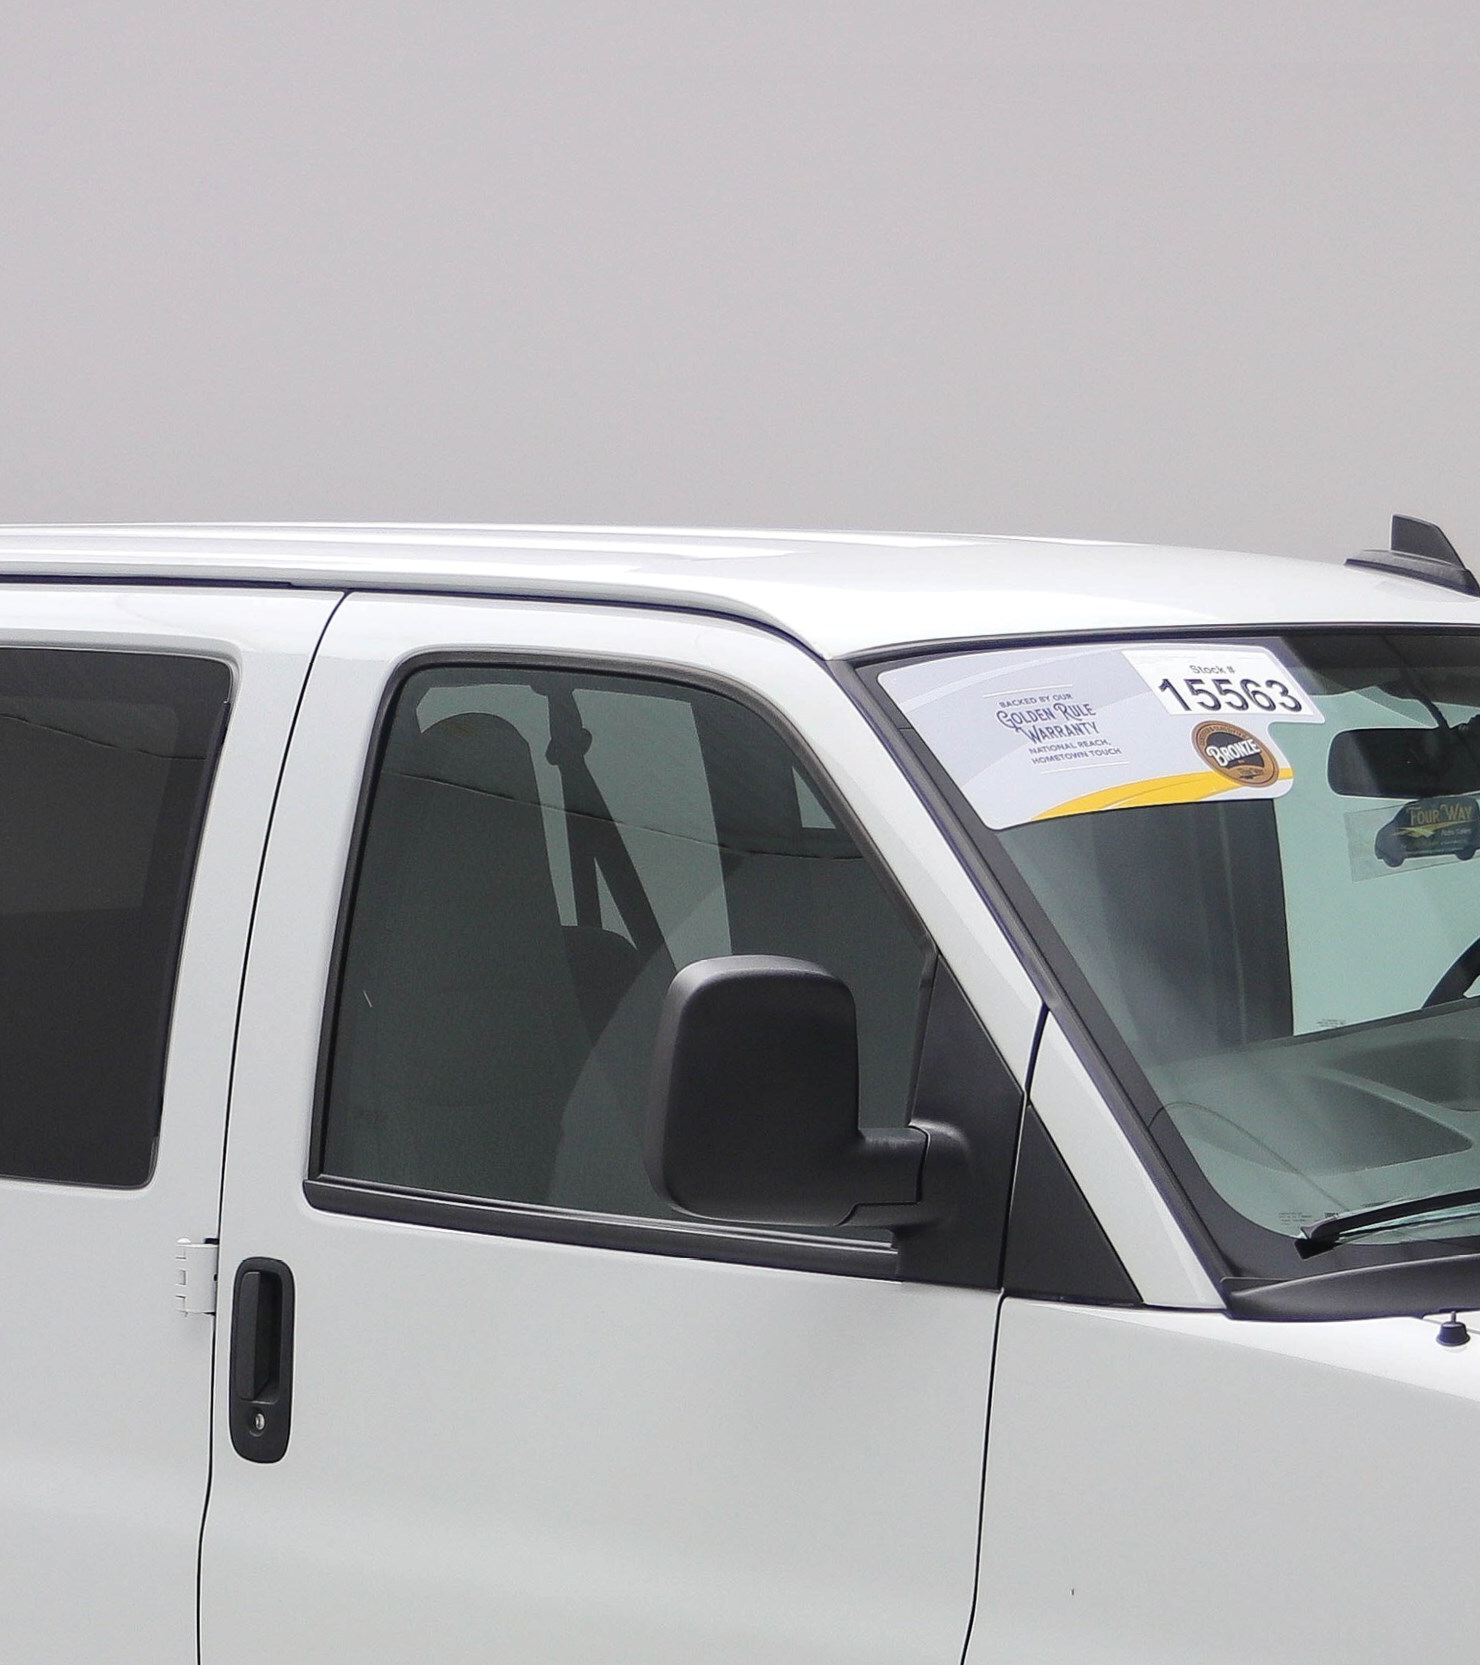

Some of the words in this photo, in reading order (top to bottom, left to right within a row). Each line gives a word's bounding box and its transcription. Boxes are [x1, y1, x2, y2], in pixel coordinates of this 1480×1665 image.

[1189, 665, 1226, 675] Stock
[999, 697, 1037, 708] BACKED
[1039, 694, 1051, 704] BY
[1052, 693, 1073, 702] OUR
[1158, 678, 1302, 712] 15563
[996, 707, 1056, 729] GOLDEN
[1053, 702, 1096, 721] RULE
[1015, 722, 1100, 744] WARRANTY
[1029, 741, 1078, 755] NATIONAL
[1031, 751, 1089, 764] HOMETOWN
[1090, 748, 1122, 757] TOUCH
[1206, 739, 1260, 766] BRONZE
[1440, 803, 1473, 820] WAY
